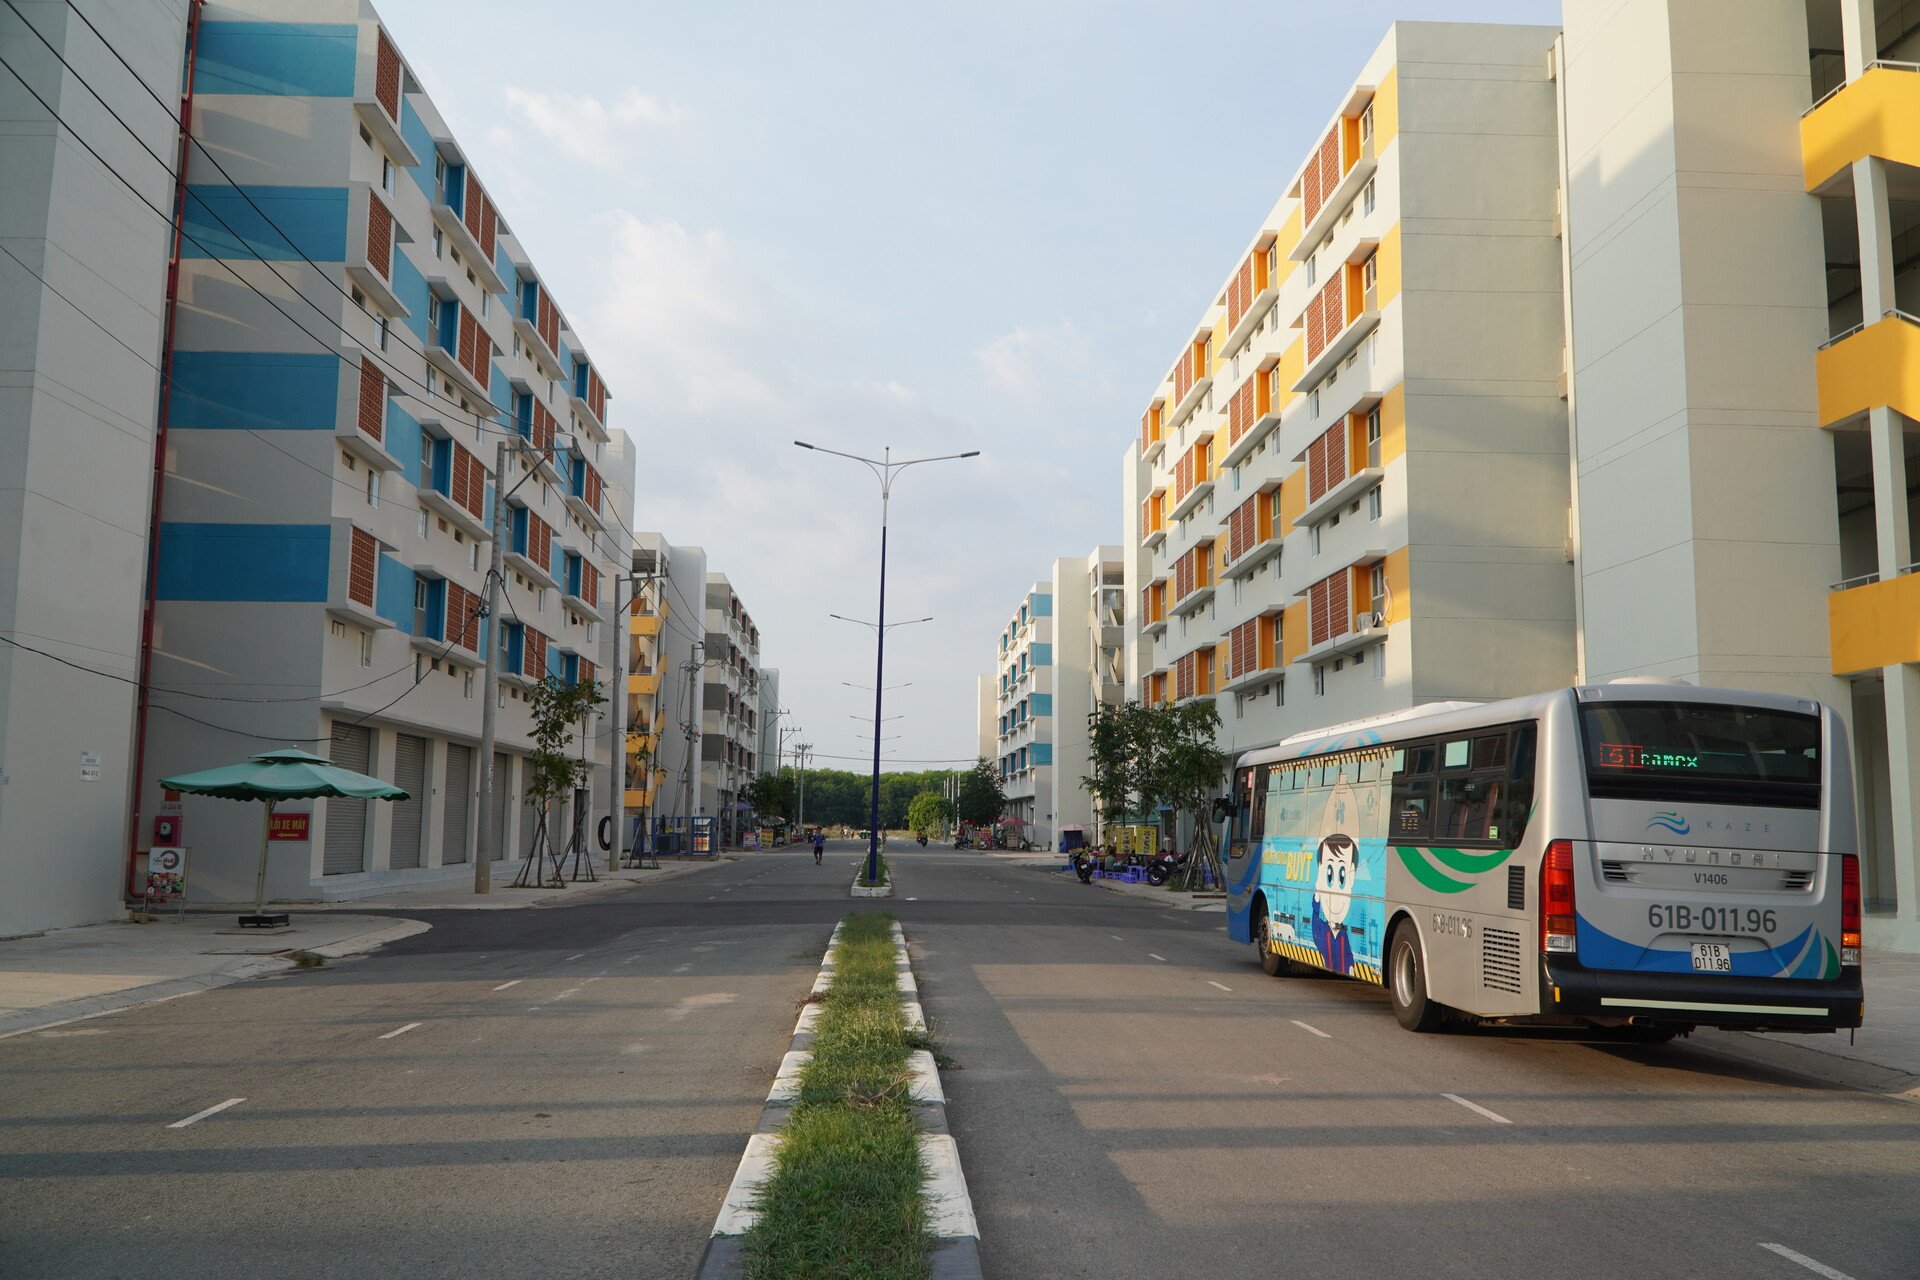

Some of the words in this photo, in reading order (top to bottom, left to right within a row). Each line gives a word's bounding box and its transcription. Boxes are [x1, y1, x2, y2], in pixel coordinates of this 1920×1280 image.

[282, 819, 290, 830] XE
[291, 817, 306, 830] MÁY
[1706, 821, 1770, 832] KAZE
[1641, 847, 1780, 867] HYUNDAI
[1693, 872, 1728, 885] V1406
[1648, 904, 1777, 933] 61B-011.96
[1700, 945, 1720, 957] 61B
[1694, 957, 1730, 970] 011.96
